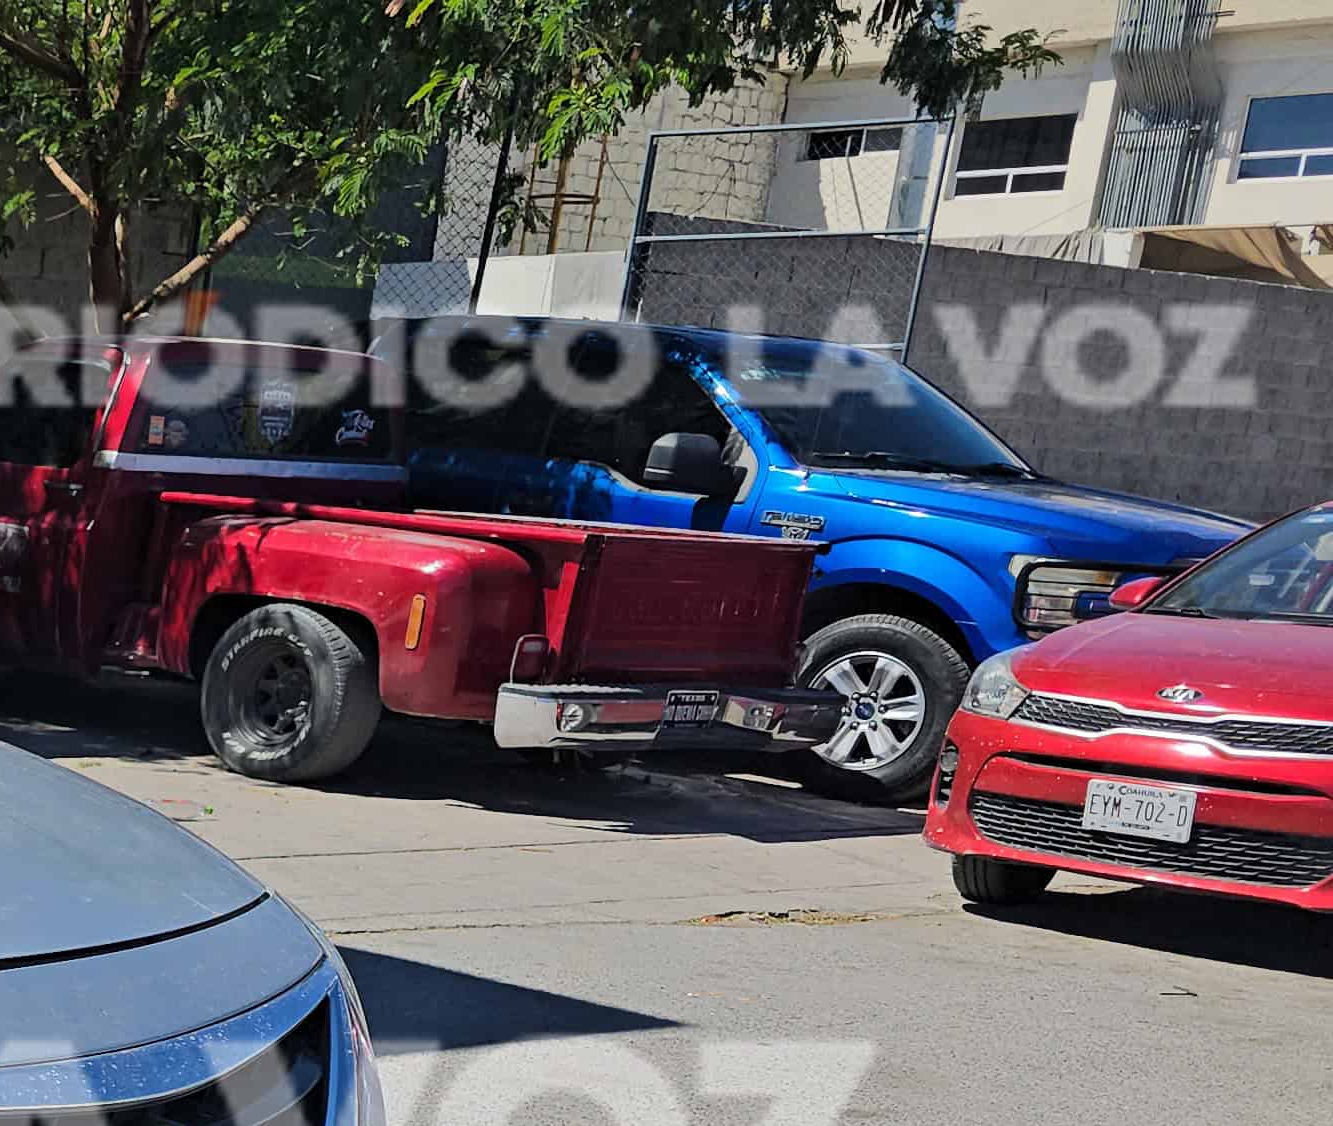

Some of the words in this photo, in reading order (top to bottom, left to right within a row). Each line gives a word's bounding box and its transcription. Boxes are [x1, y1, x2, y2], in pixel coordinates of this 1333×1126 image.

[1160, 686, 1197, 701] KIA
[1118, 785, 1163, 800] COAHUILA
[1089, 793, 1189, 828] EYM-702-D
